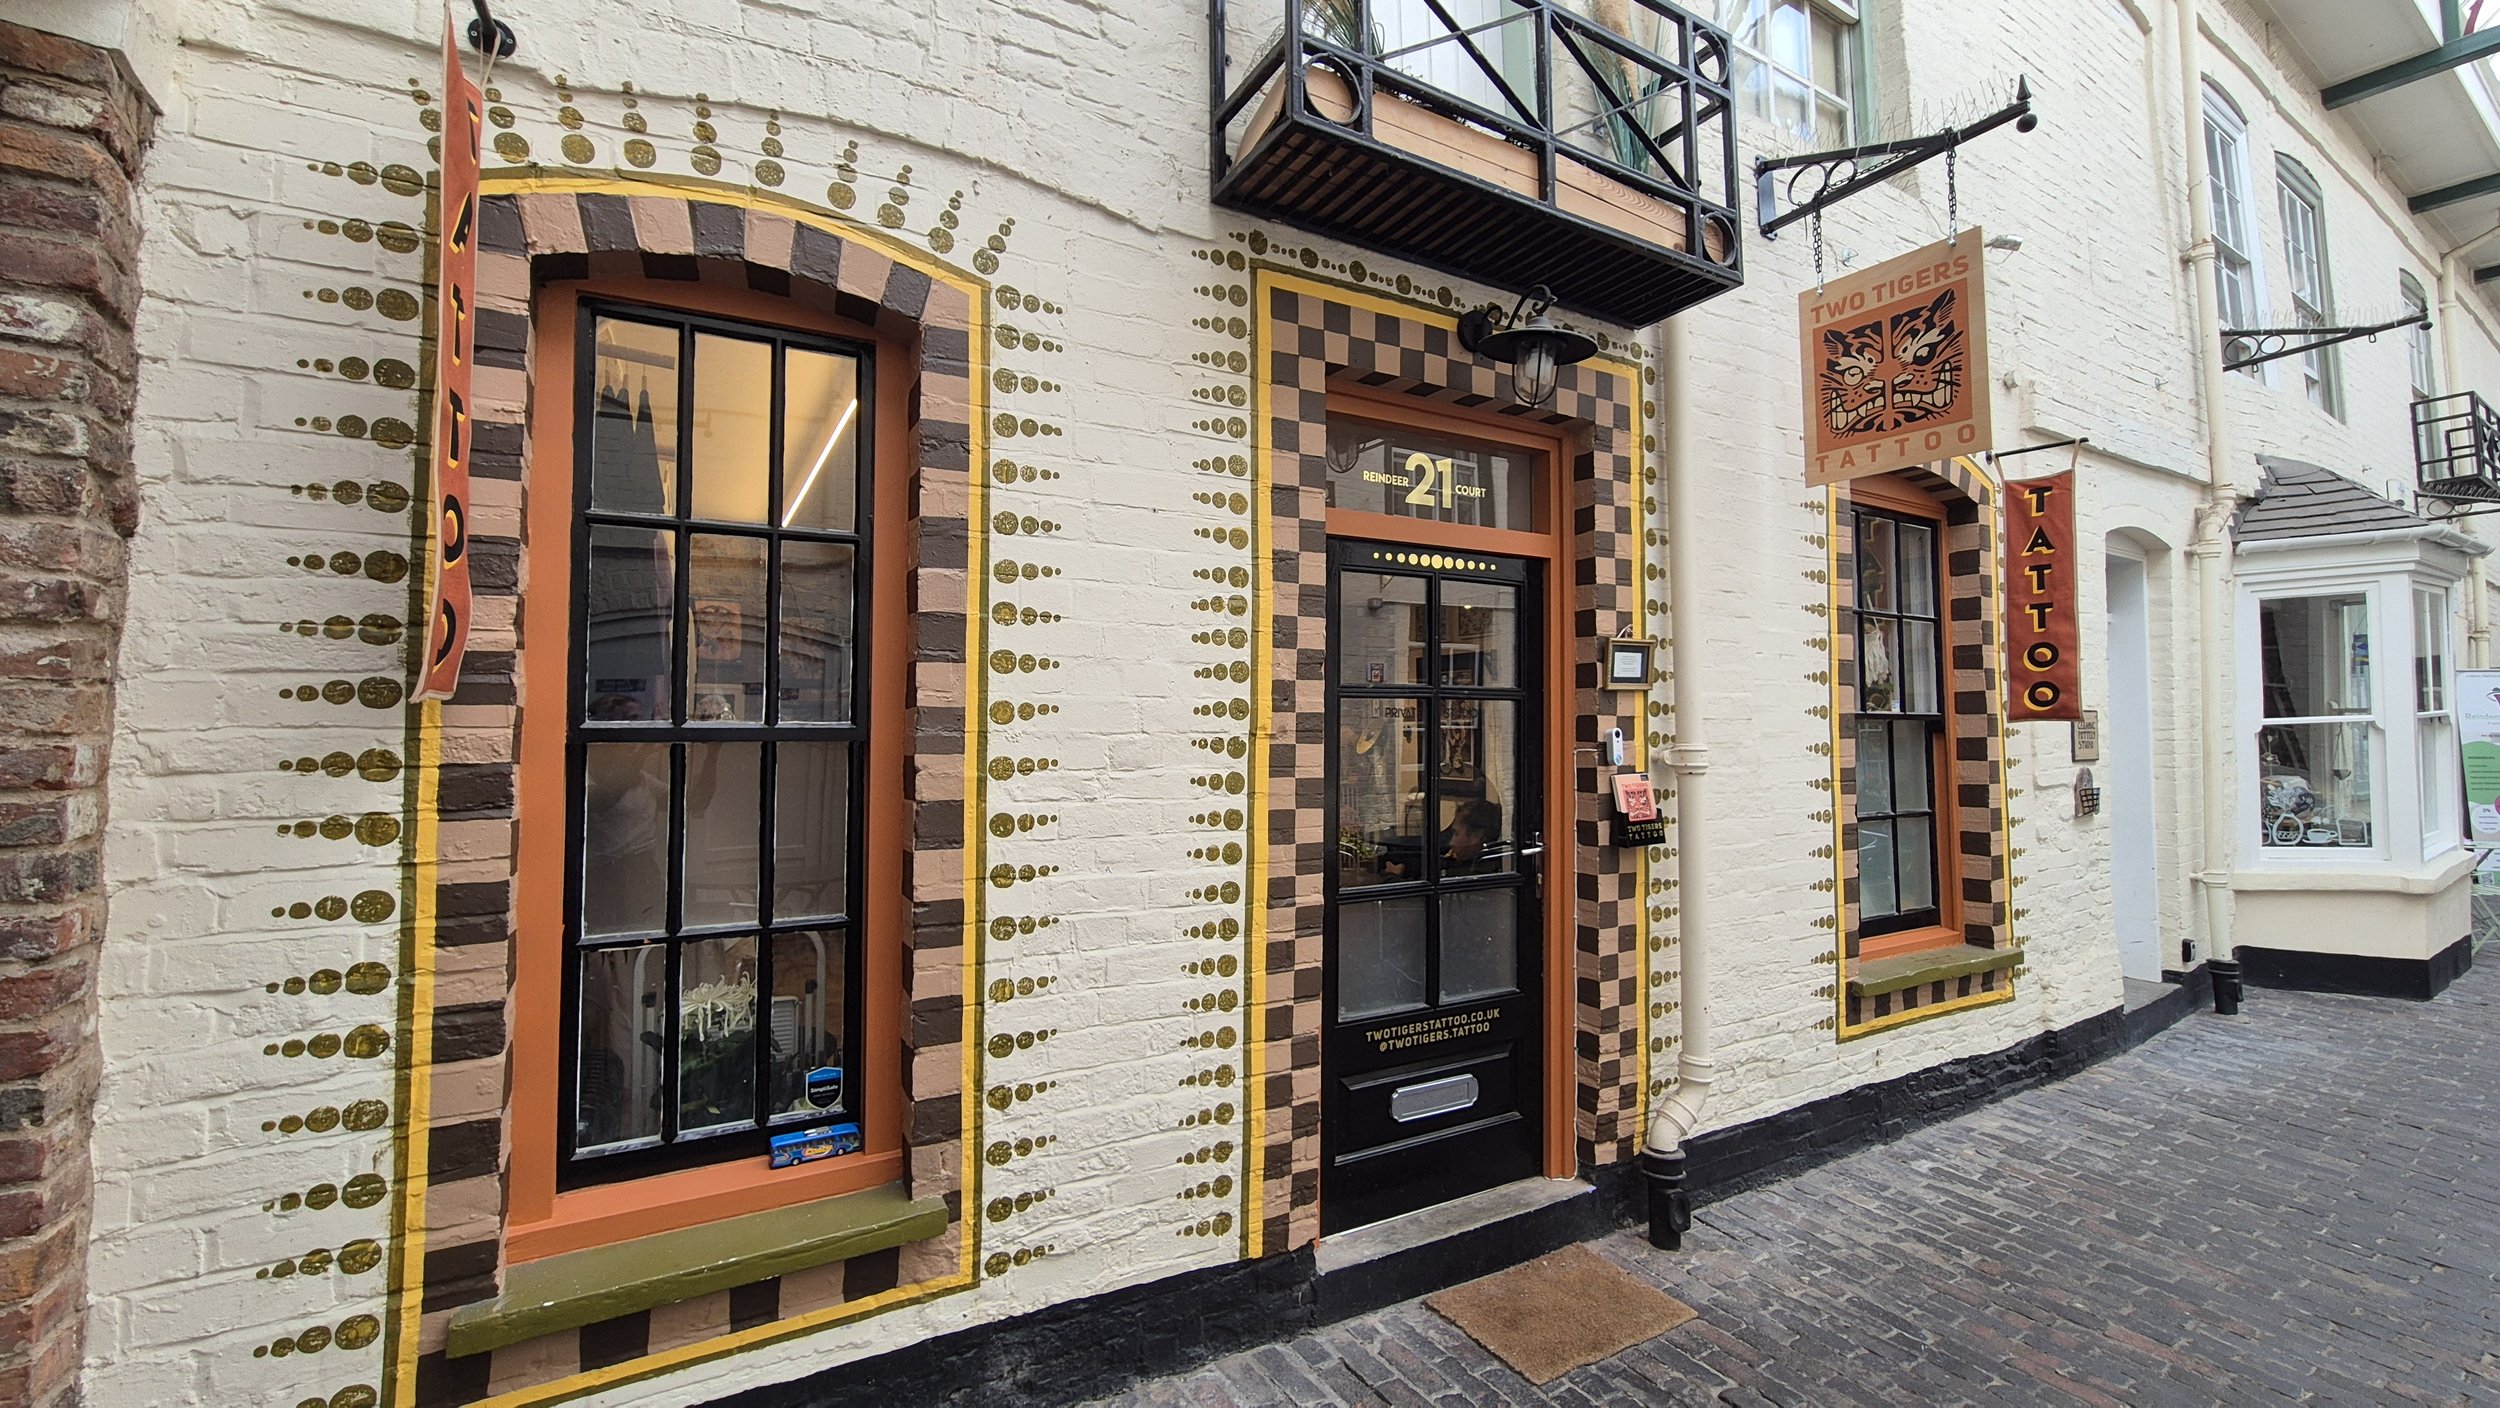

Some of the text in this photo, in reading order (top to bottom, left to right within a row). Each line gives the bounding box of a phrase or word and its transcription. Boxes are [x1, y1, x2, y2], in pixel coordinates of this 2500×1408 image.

[1810, 254, 1970, 324] TWO TIGERS
[1816, 423, 1976, 473] TATTOO
[1363, 452, 1487, 509] REINDEER 21 COURT
[2021, 486, 2060, 711] TATTOO
[1384, 707, 1419, 719] PRIVAT
[1629, 830, 1664, 840] TATTOO
[1366, 1008, 1500, 1042] TWOTIGERSTATTOO.CO.UK
[1379, 1022, 1490, 1052] @TWOTIGERS.TATTOO
